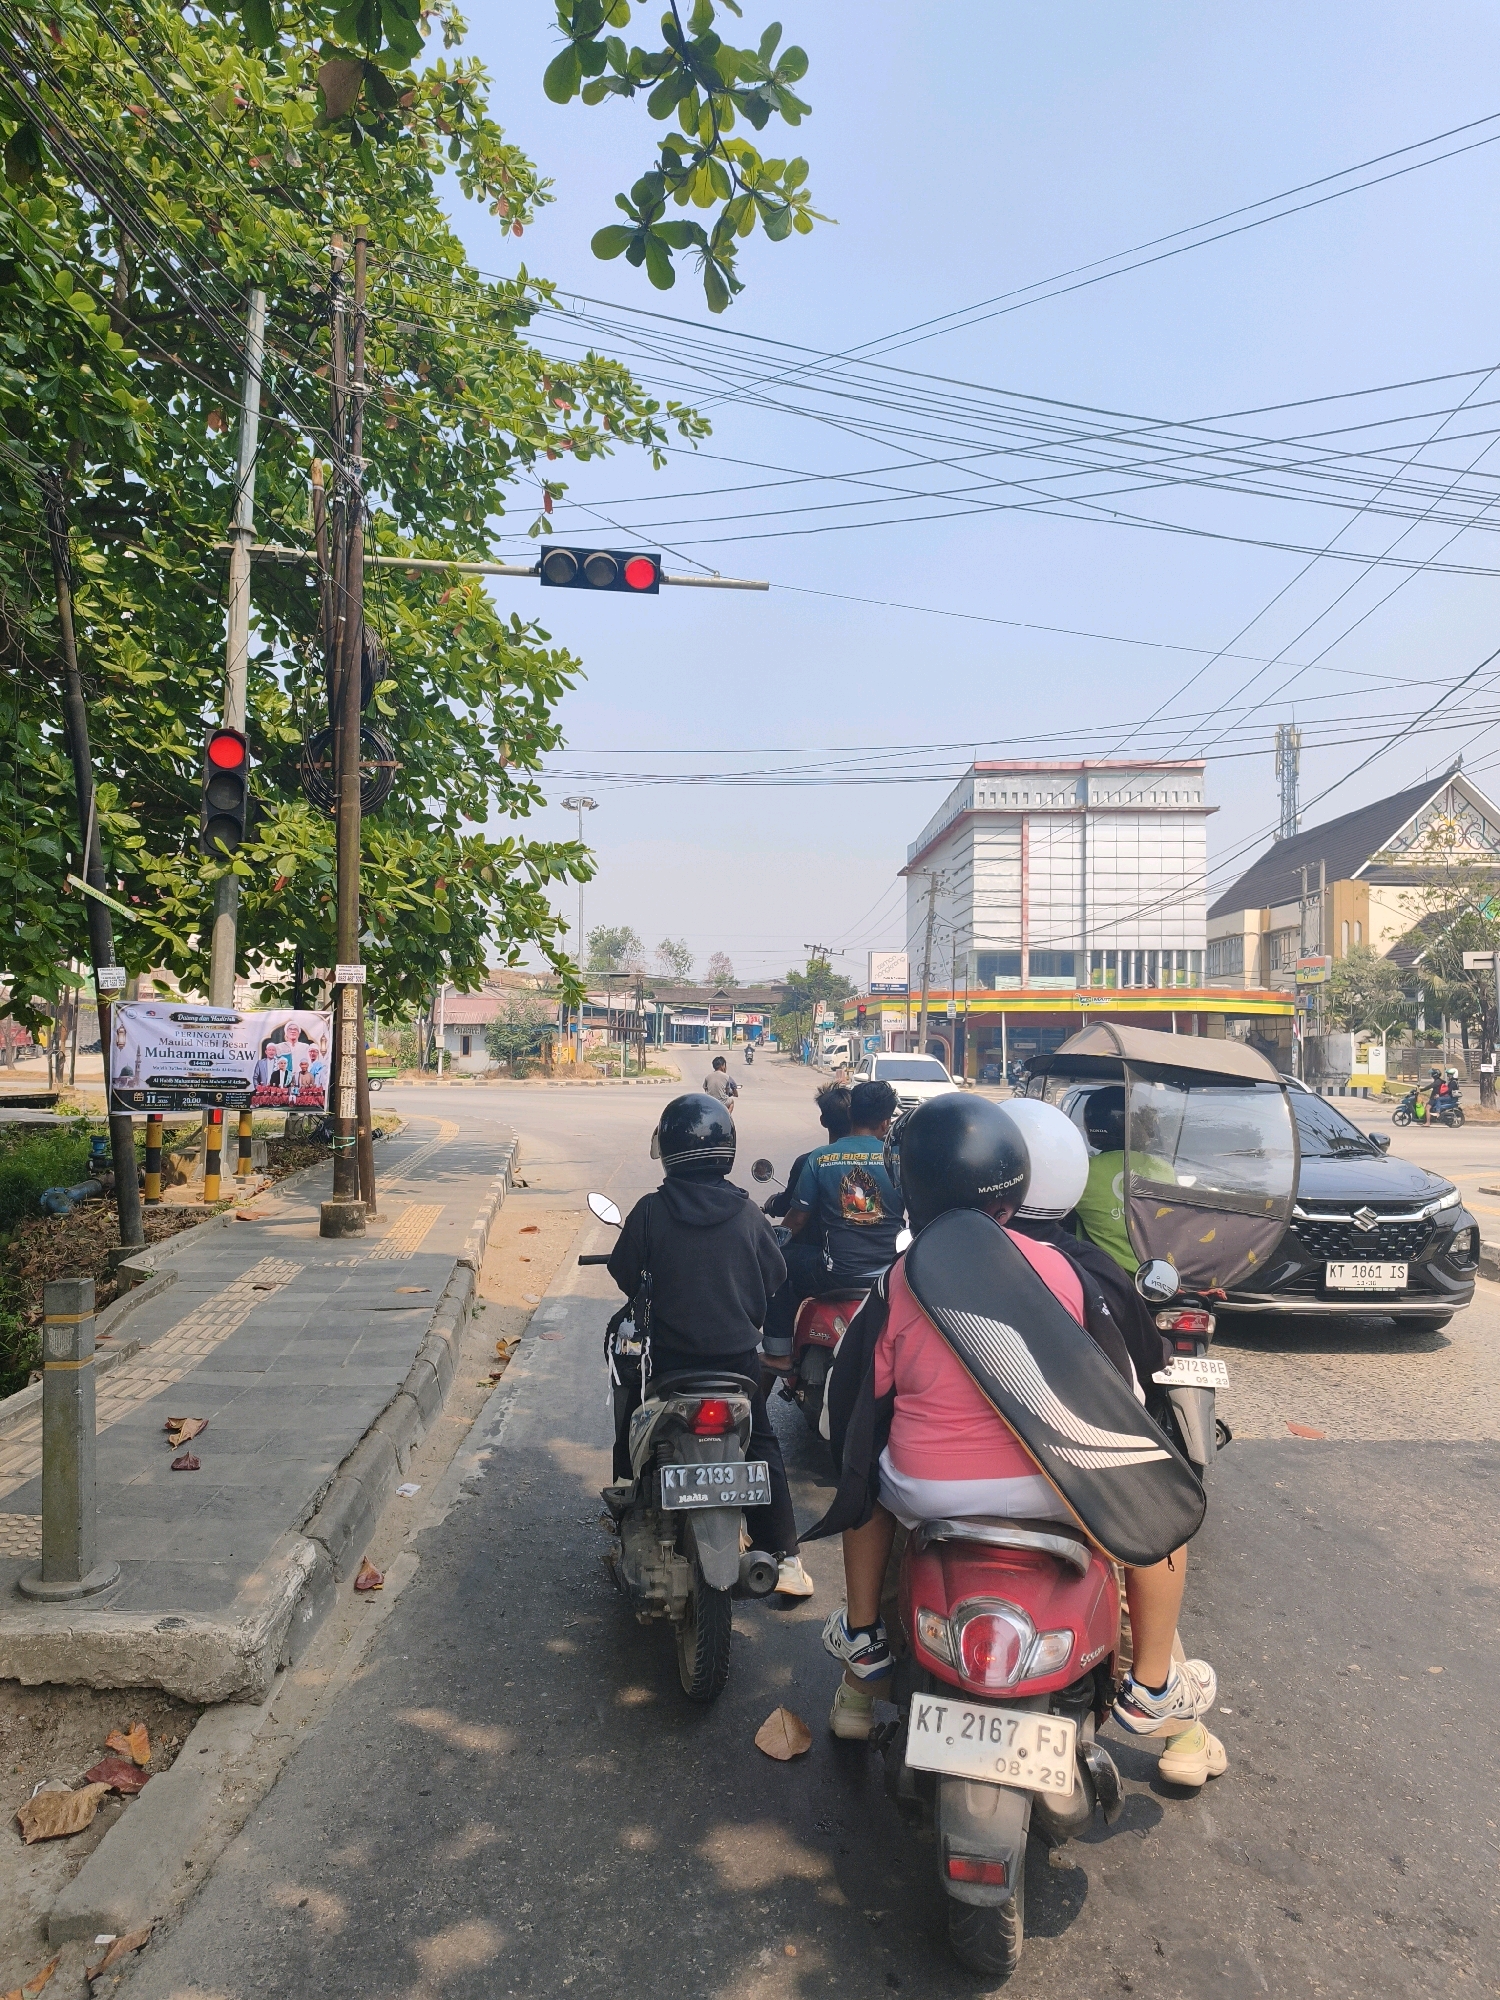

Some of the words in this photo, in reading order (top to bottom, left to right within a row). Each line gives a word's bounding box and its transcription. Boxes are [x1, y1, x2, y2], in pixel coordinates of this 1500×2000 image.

[175, 1031, 234, 1039] PERINGATAN
[159, 1037, 193, 1047] Maulid
[196, 1039, 219, 1048] Nabi
[222, 1039, 249, 1049] Besar
[145, 1046, 225, 1060] Muhammad
[228, 1049, 257, 1061] SAW
[146, 1095, 156, 1104] 11
[978, 1173, 1024, 1194] MARCOLINO
[1329, 1264, 1345, 1278] KT
[1352, 1265, 1382, 1279] 1861
[1389, 1265, 1405, 1279] IS
[664, 1468, 687, 1488] KT
[695, 1466, 734, 1485] 2133
[916, 1704, 948, 1734] KT
[960, 1712, 1020, 1747] 2167
[1036, 1724, 1068, 1757] FJ
